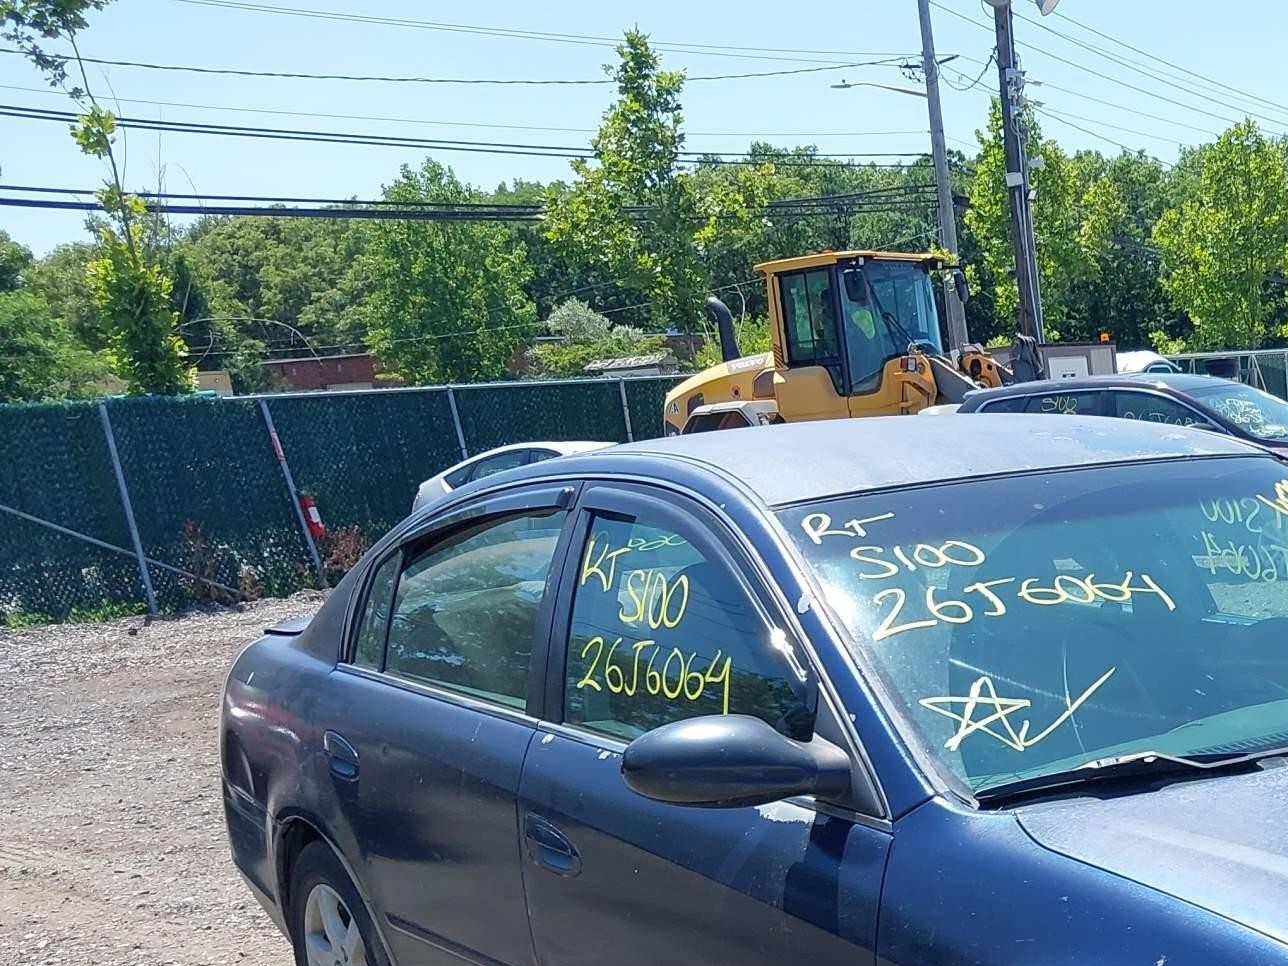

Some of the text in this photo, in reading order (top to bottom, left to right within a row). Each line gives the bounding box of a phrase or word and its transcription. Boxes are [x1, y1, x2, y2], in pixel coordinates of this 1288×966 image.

[801, 512, 895, 544] RT
[850, 540, 986, 580] S100
[618, 568, 690, 630] S100
[872, 571, 1177, 641] 26J6064
[576, 636, 732, 716] 26J6064
